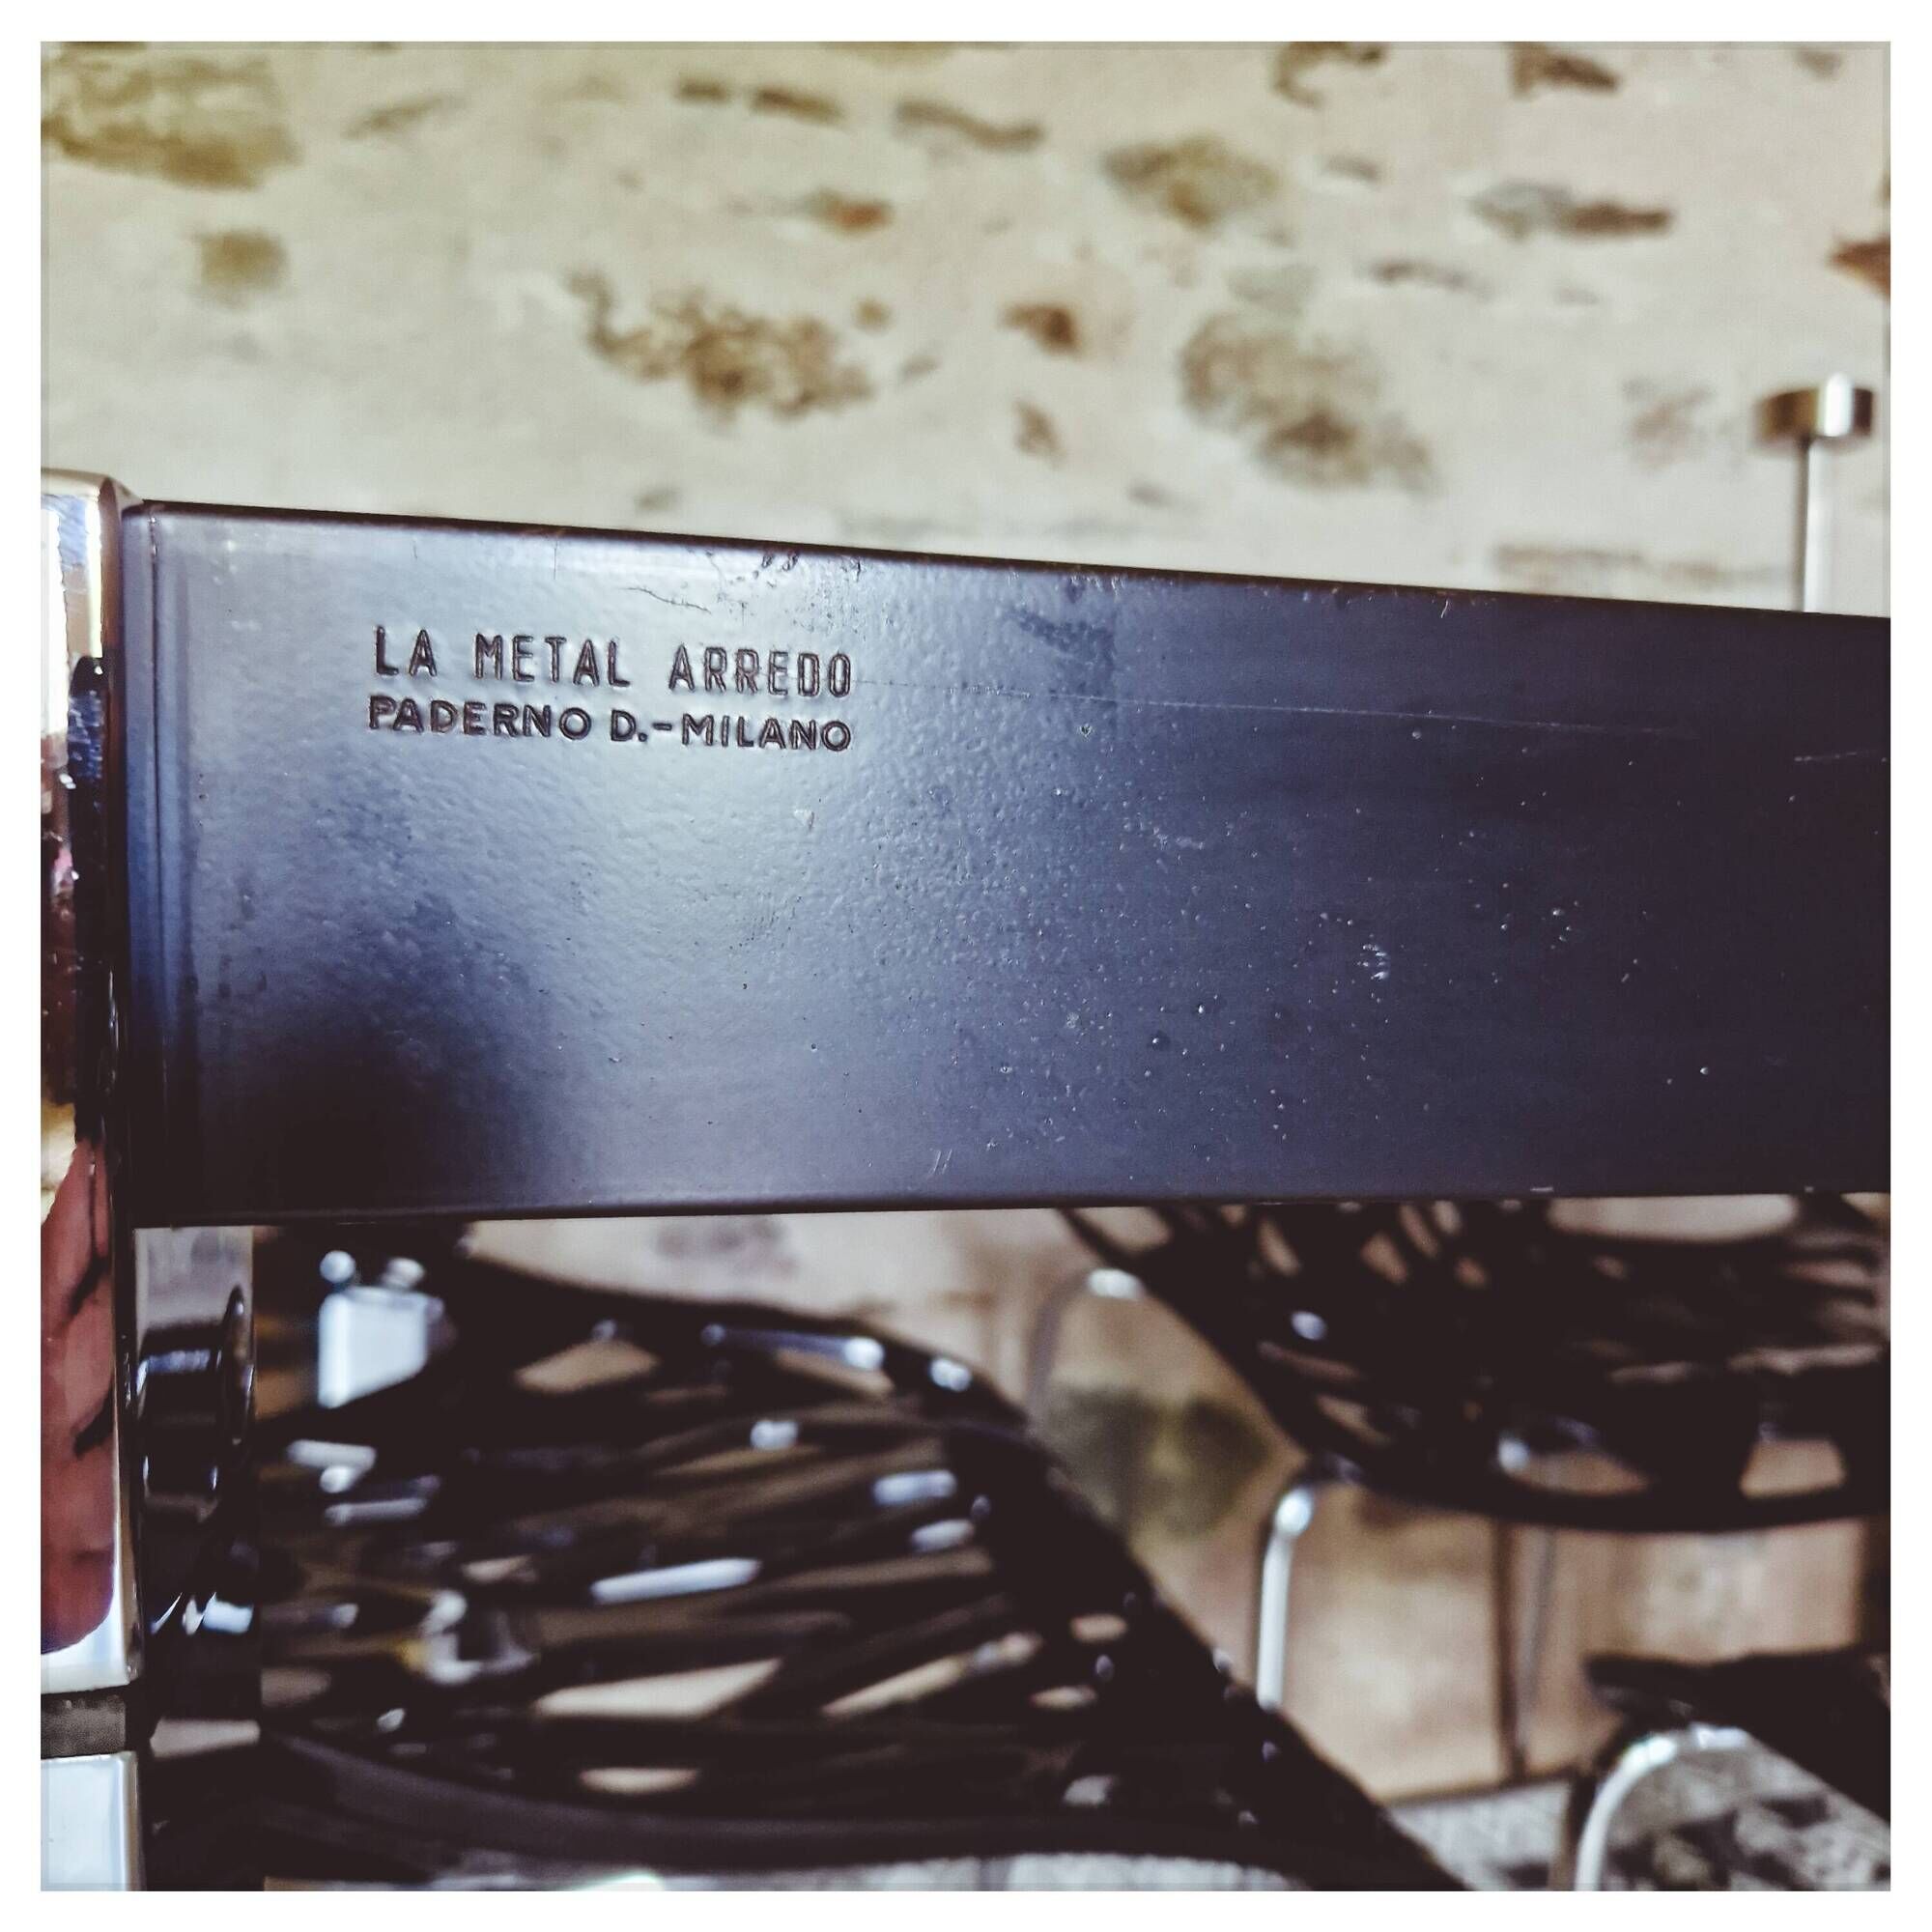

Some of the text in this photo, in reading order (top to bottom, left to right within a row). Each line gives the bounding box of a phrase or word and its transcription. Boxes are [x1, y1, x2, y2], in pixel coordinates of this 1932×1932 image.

[375, 625, 853, 698] LA METAL ARREDO
[368, 695, 591, 741] PADERNO
